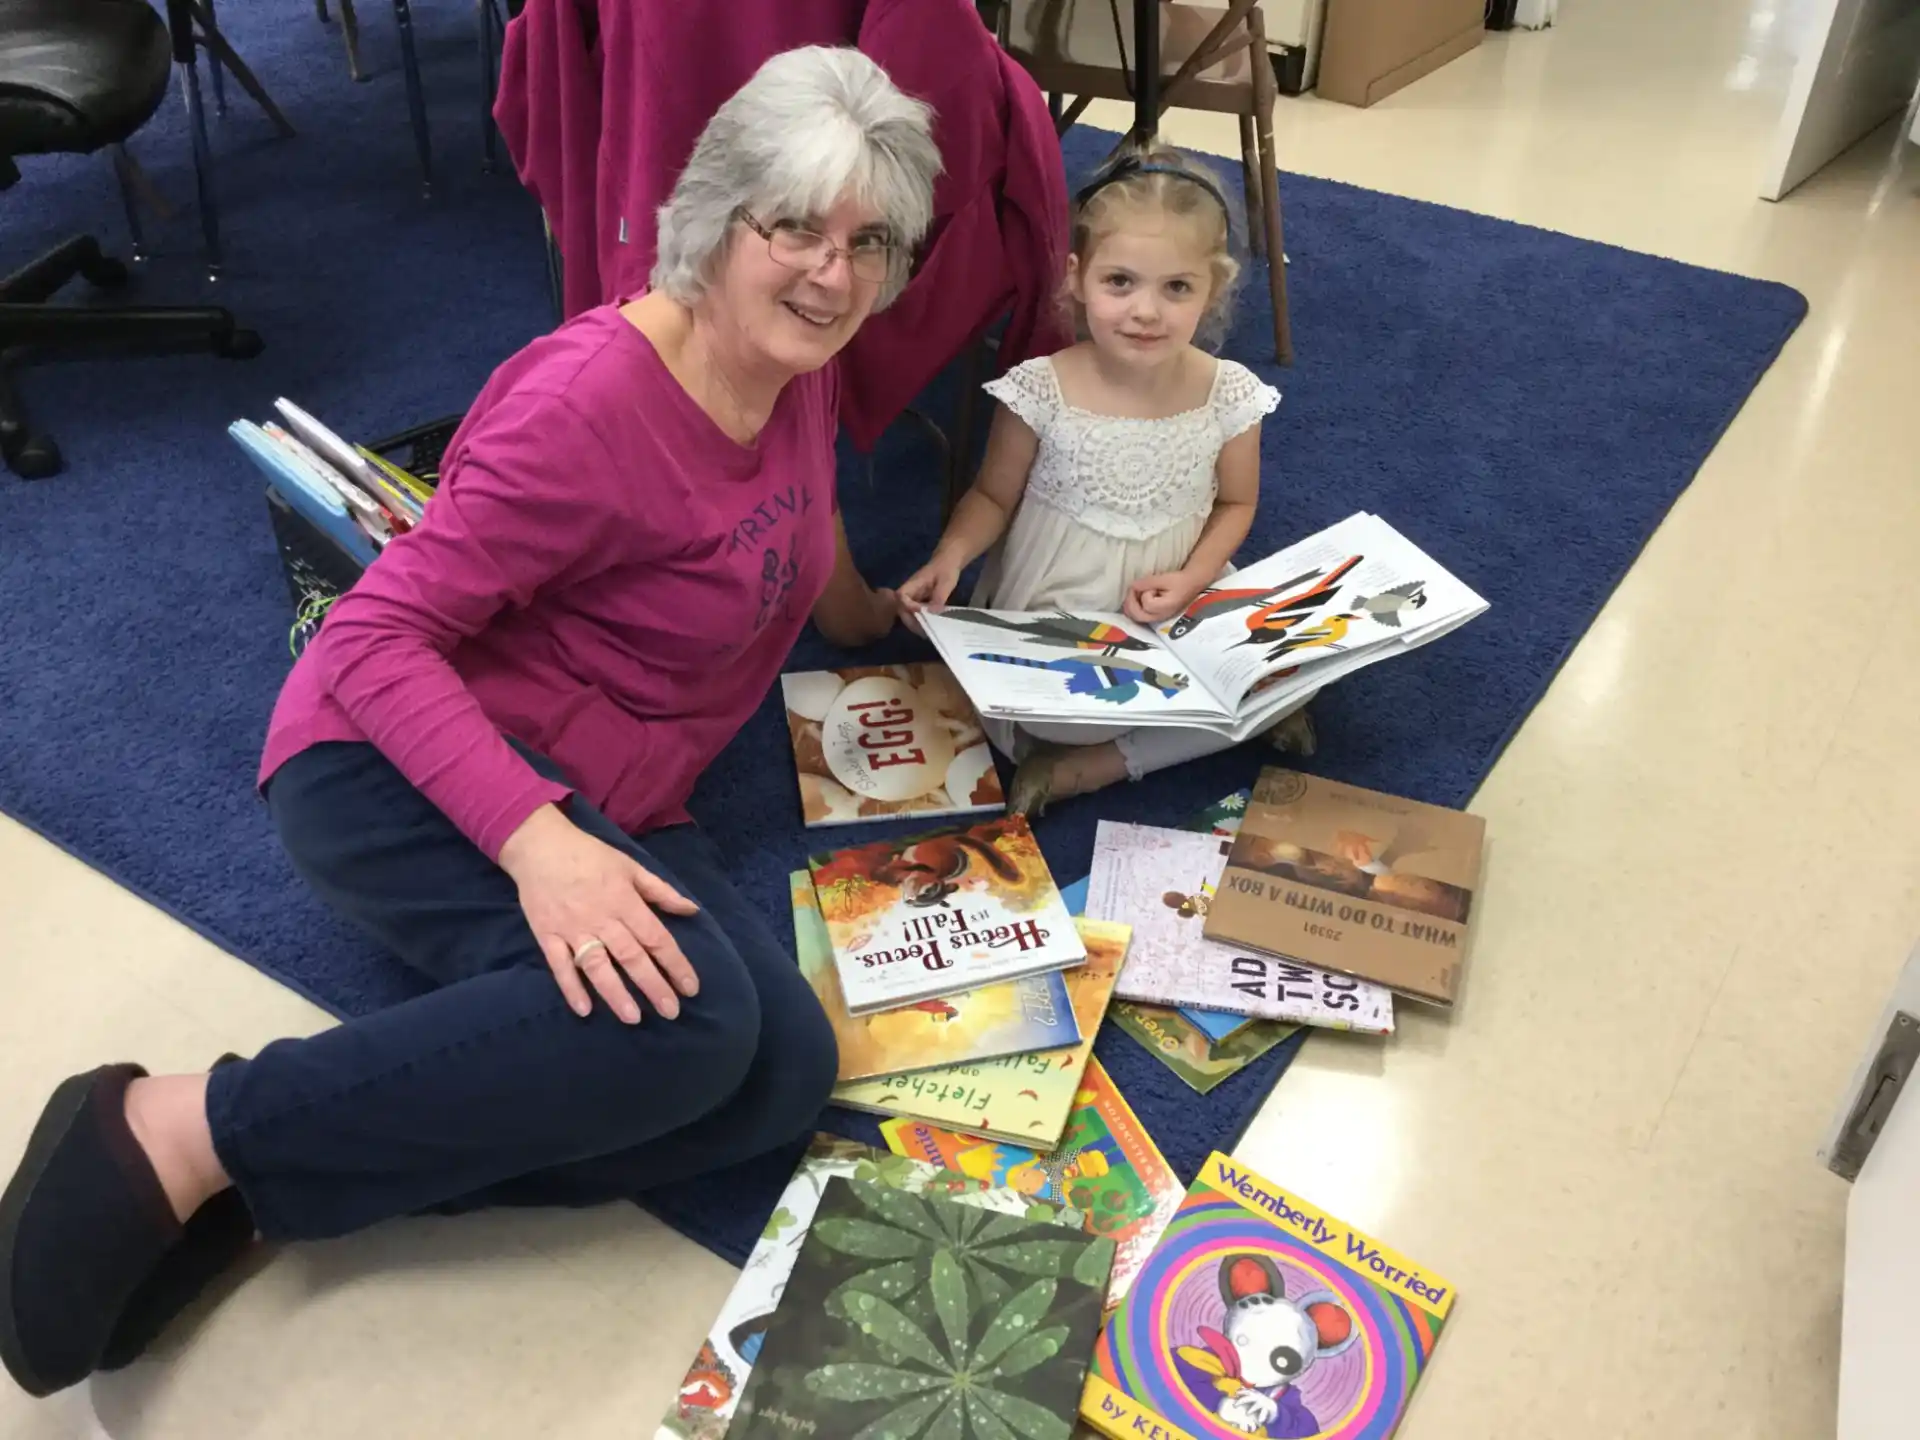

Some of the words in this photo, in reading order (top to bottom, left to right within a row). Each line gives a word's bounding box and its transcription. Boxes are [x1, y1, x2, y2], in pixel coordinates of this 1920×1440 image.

[847, 698, 926, 771] EGG!
[1228, 875, 1266, 896] BOX
[1269, 885, 1283, 902] A
[1285, 890, 1333, 915] WITH
[1338, 905, 1367, 924] DO
[902, 908, 970, 943] Fall!
[950, 919, 1050, 952] Hocus
[1370, 913, 1395, 933] TO
[1401, 921, 1457, 947] WHAT
[1231, 956, 1268, 999] AD
[1135, 1015, 1179, 1050] Over
[882, 1075, 992, 1111] Fletcher
[1218, 1162, 1336, 1244] Wemberly
[1346, 1232, 1446, 1305] Worried
[1101, 1393, 1127, 1420] by
